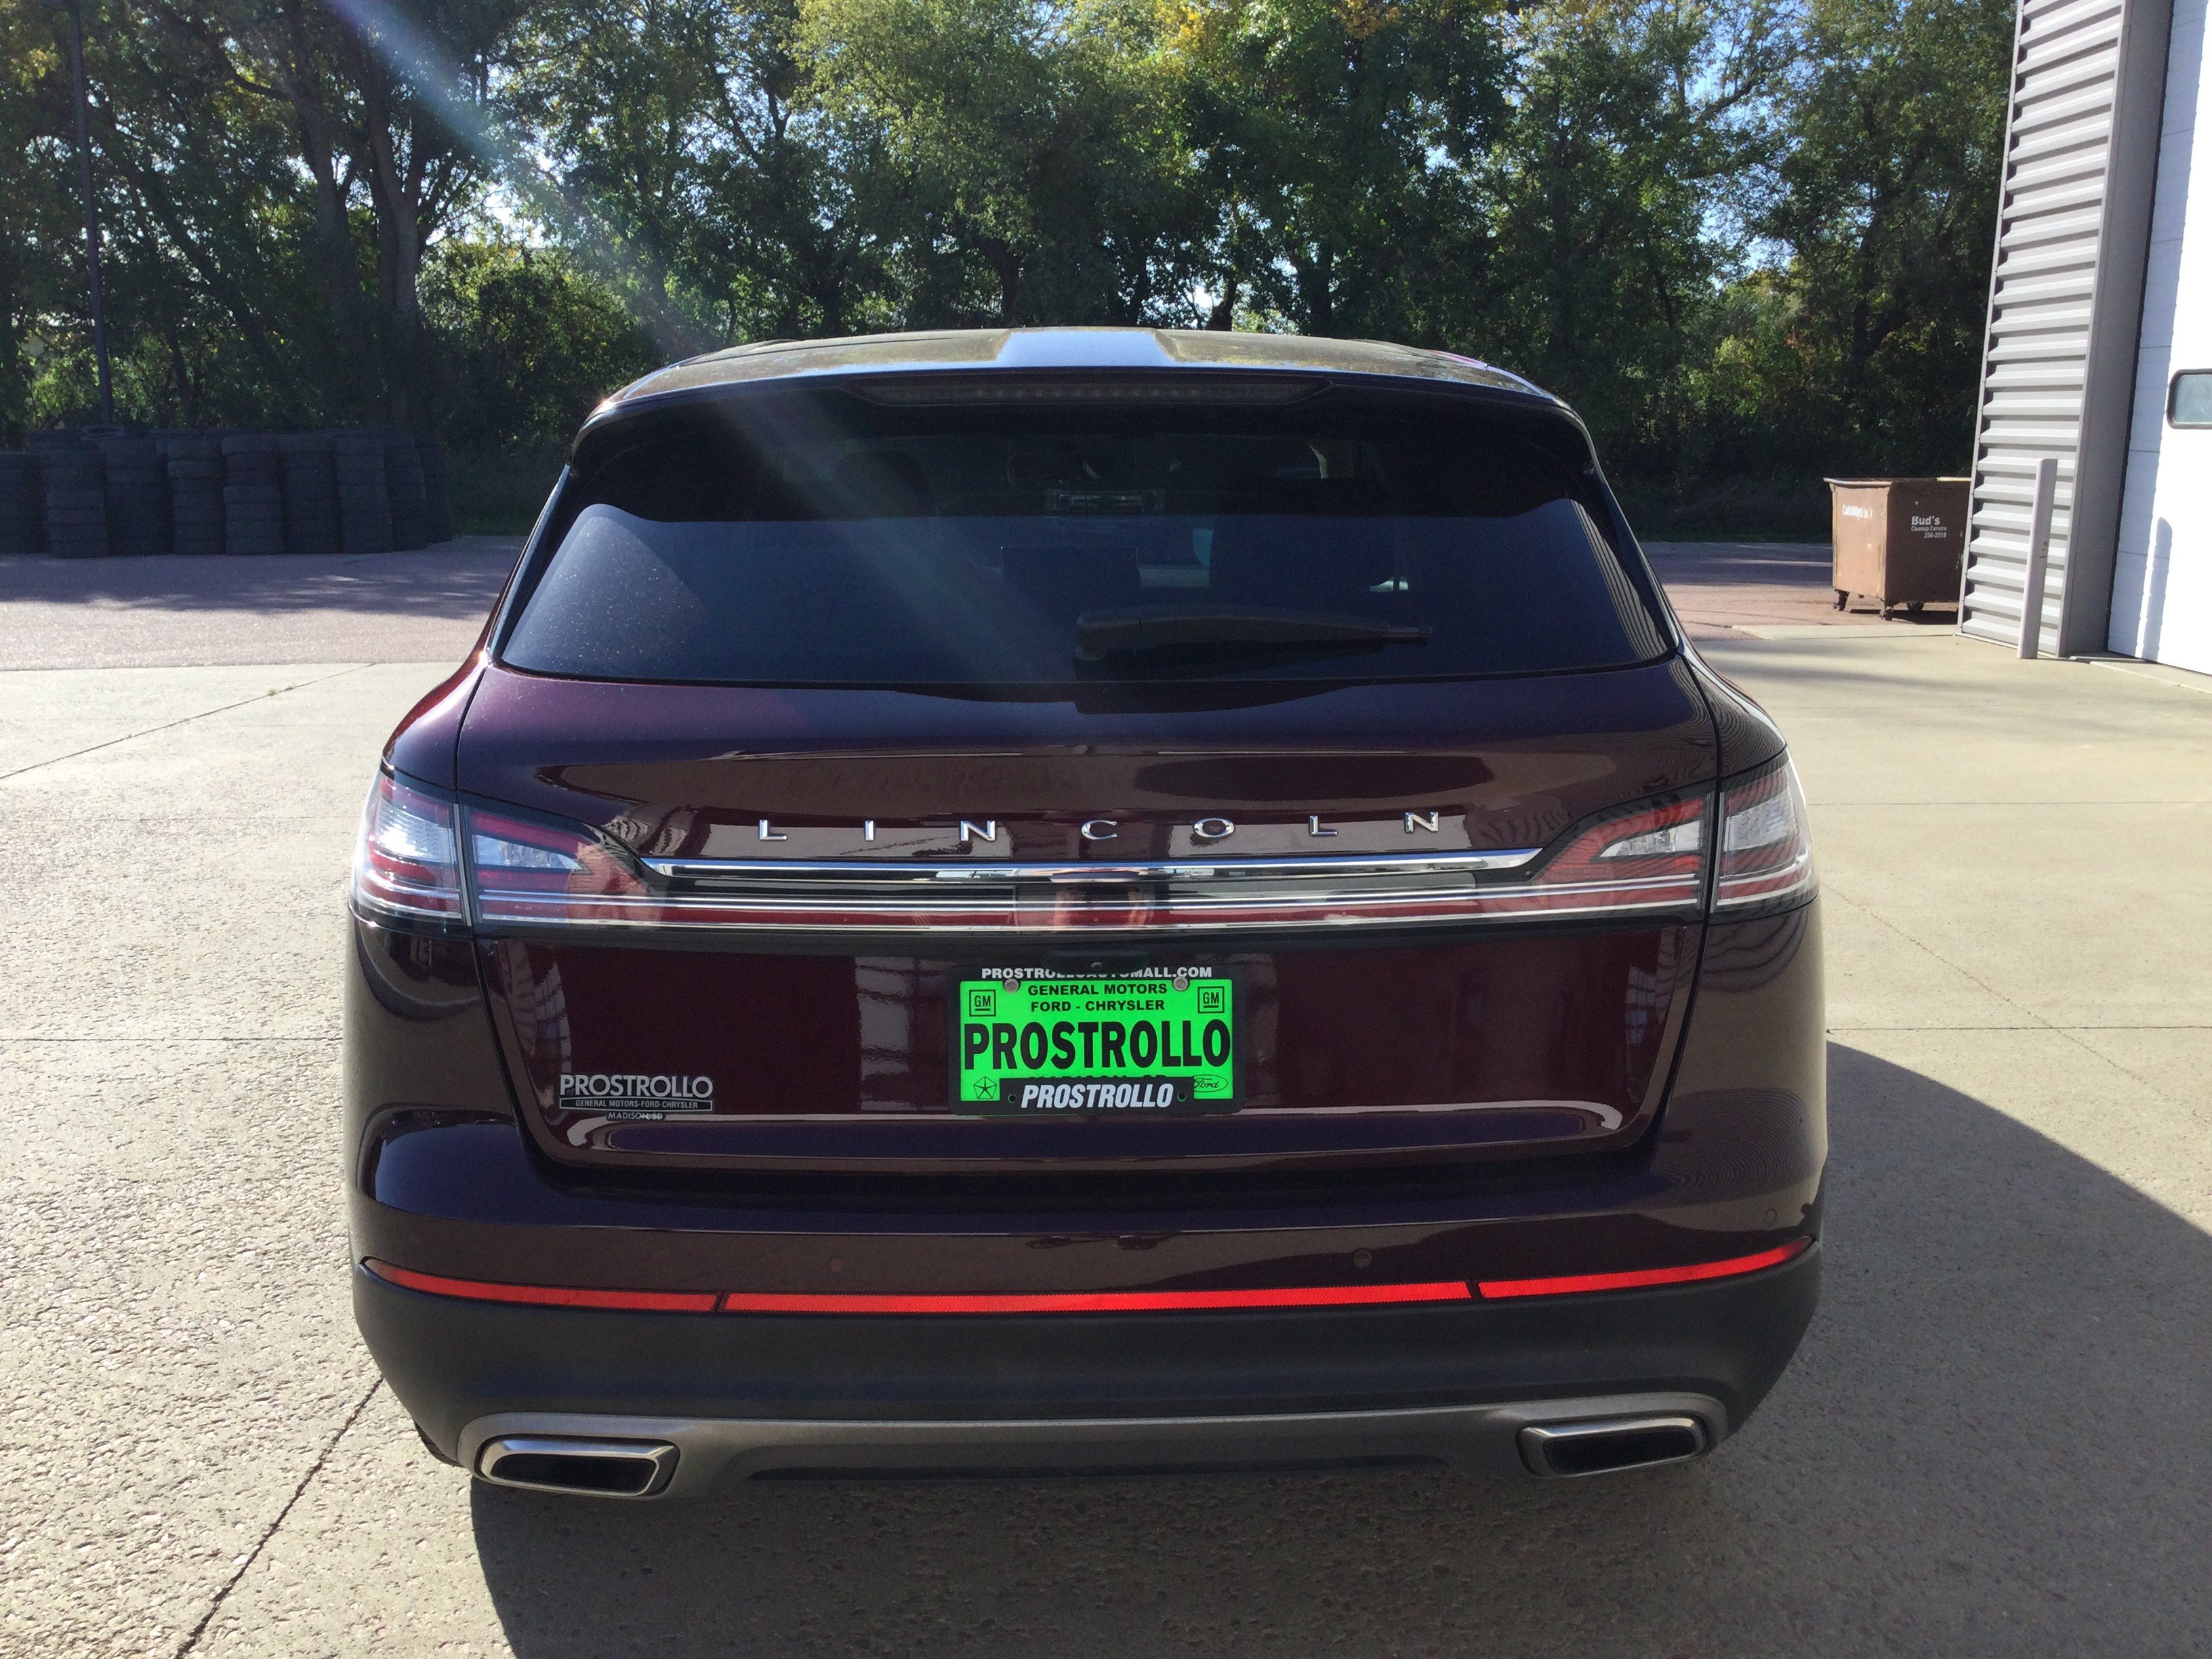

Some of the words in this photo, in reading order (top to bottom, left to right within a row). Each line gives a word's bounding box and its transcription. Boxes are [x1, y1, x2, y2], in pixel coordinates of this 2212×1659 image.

[1911, 515, 1940, 525] Bud's
[759, 811, 1439, 842] LINCOLN
[981, 966, 1212, 979] PROSTROLMALL.COM
[1027, 985, 1099, 996] GENERAL
[1104, 983, 1168, 995] MOTORS
[974, 994, 991, 1008] GM
[1203, 991, 1220, 1004] GM
[1031, 1001, 1071, 1012] FORD
[1085, 1000, 1166, 1011] CHRYSLER
[964, 1019, 1231, 1071] PROSTROLLO
[560, 1074, 714, 1098] PROSTROLLO
[1193, 1078, 1220, 1088] Ford
[1021, 1083, 1174, 1109] PROSTROLLO
[575, 1099, 607, 1107] GENERAL
